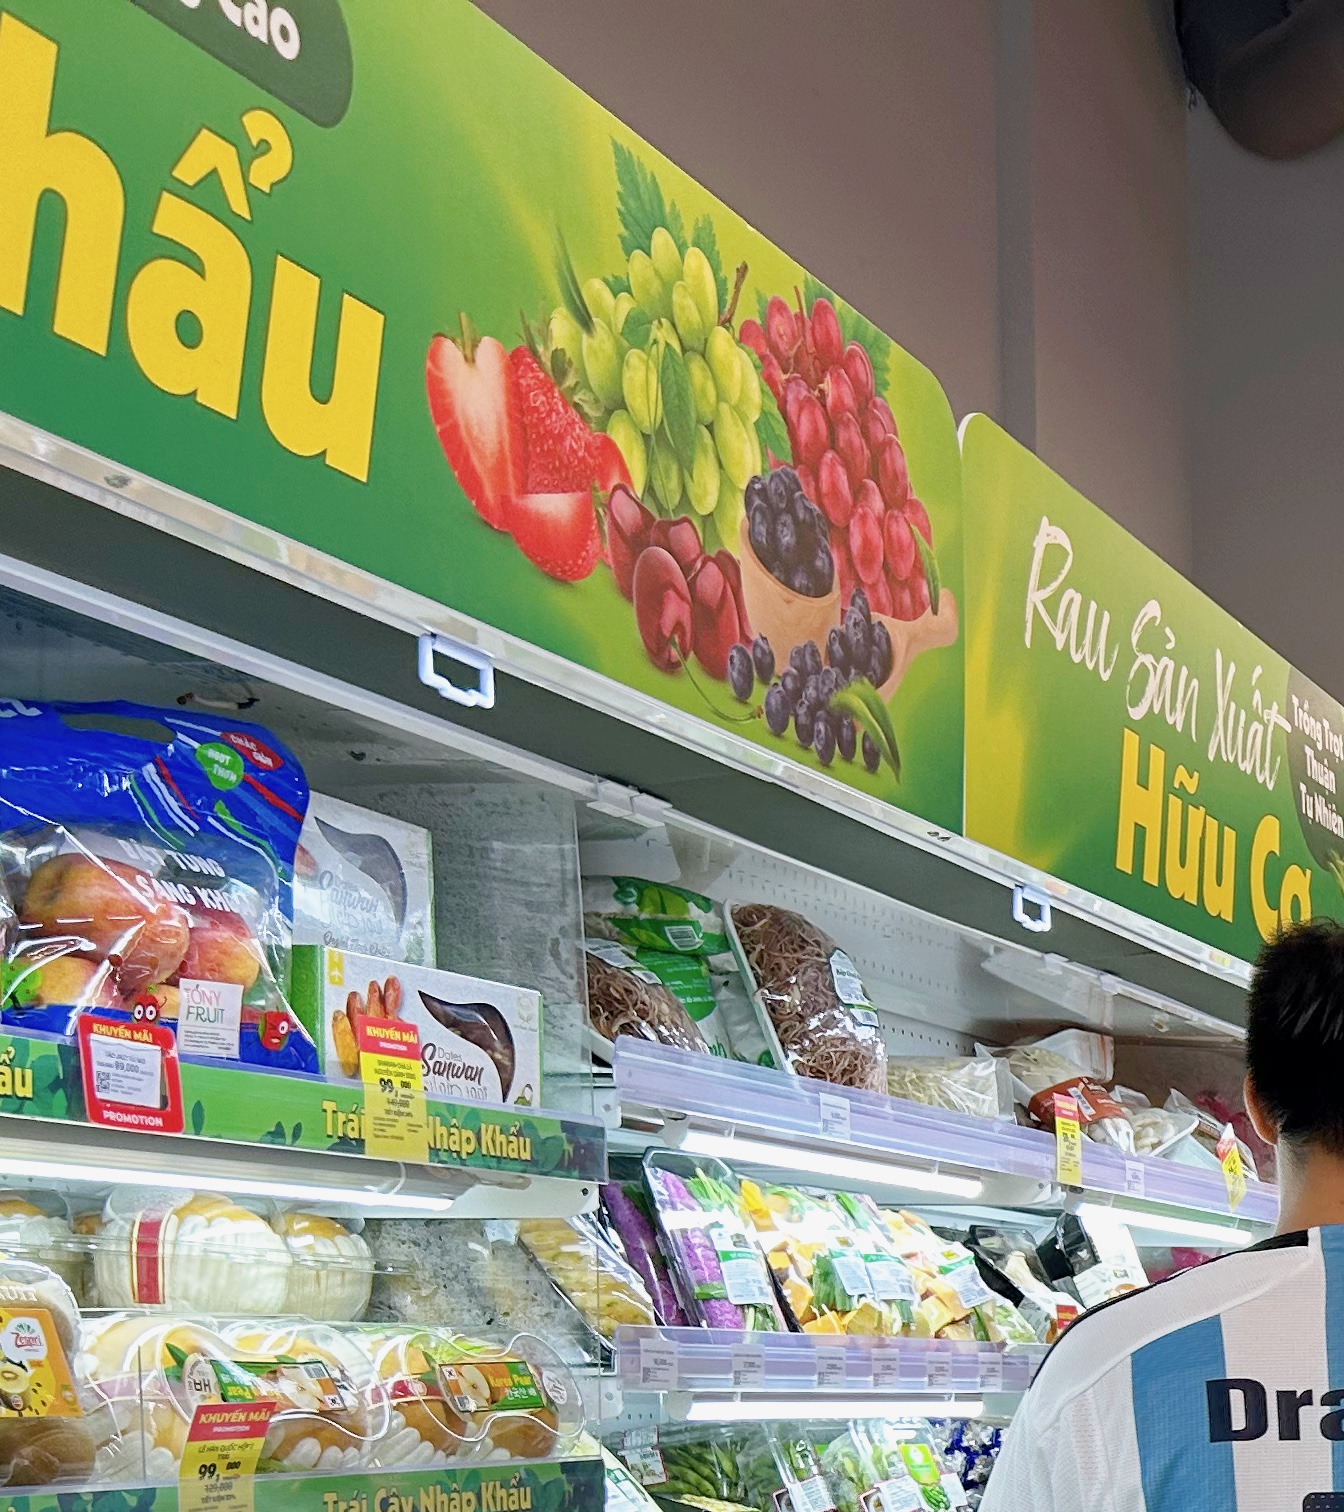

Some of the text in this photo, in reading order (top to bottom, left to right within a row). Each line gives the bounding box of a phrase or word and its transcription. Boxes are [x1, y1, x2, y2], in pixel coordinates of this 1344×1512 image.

[1025, 515, 1119, 683] Rau
[1208, 650, 1291, 792] Xuất
[1322, 717, 1344, 764] Trọt
[1304, 744, 1337, 796] Thuận
[1115, 725, 1237, 925] Hữu
[1313, 791, 1344, 840] Nhiên
[173, 849, 227, 878] TUNG
[92, 1022, 152, 1043] KHUYẾN MÃI
[186, 1005, 226, 1024] FRUIT
[366, 1025, 418, 1044] KHUYẾN MÃI
[421, 1042, 485, 1085] Sanwan
[321, 1098, 365, 1141] Trái
[480, 1120, 532, 1162] Khẩu
[198, 1407, 271, 1424] KHUYẾN MÃI
